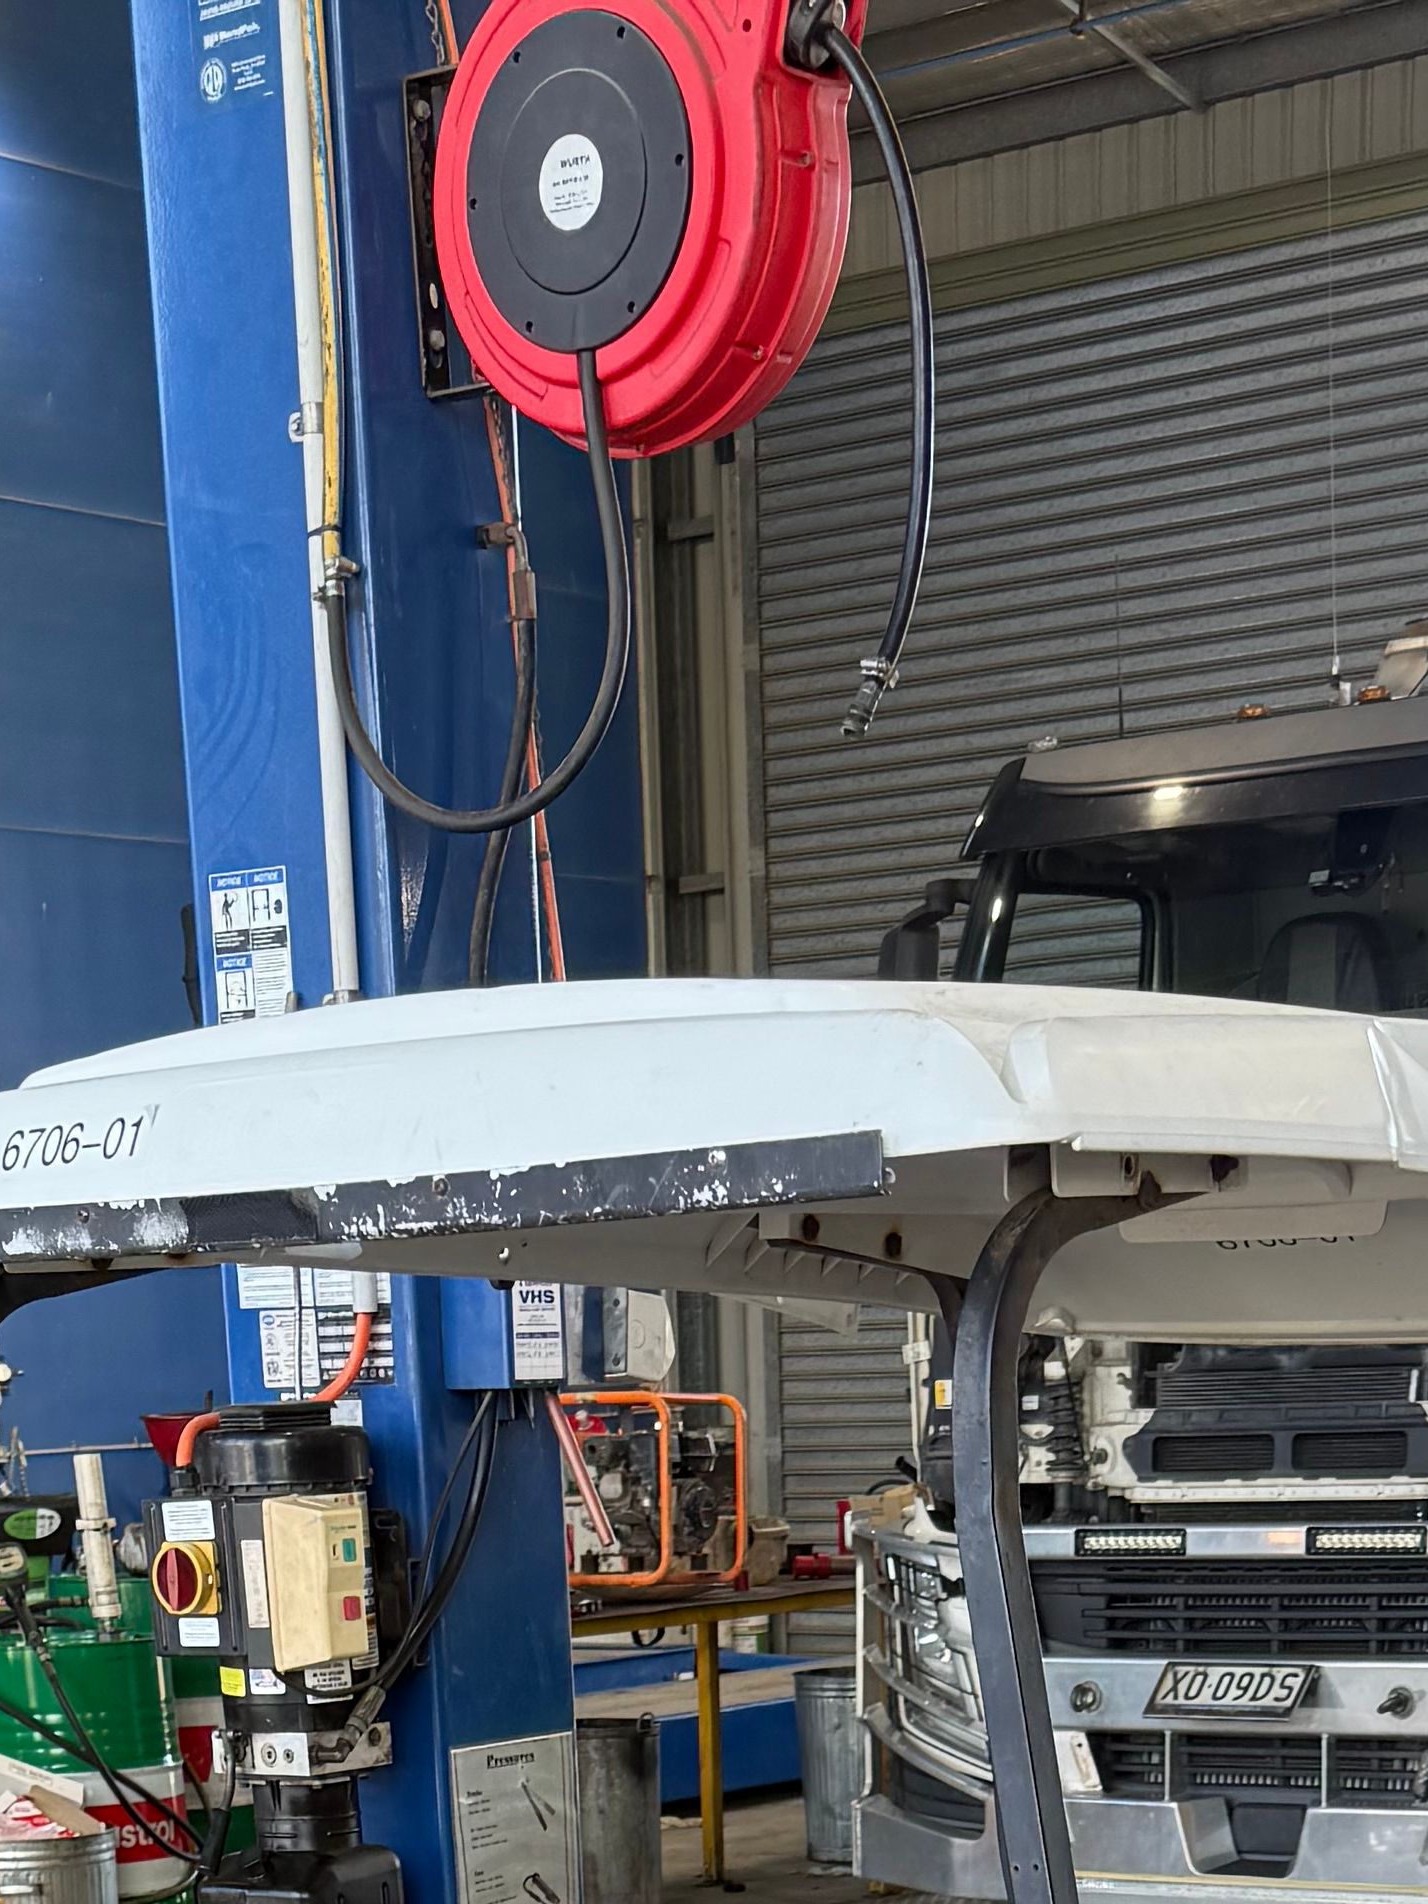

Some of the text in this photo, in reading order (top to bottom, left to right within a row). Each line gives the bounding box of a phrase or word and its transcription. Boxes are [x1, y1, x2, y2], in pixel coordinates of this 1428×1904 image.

[1, 1115, 145, 1172] 6706-01
[518, 1289, 556, 1305] VHS
[486, 1752, 535, 1769] Pressures
